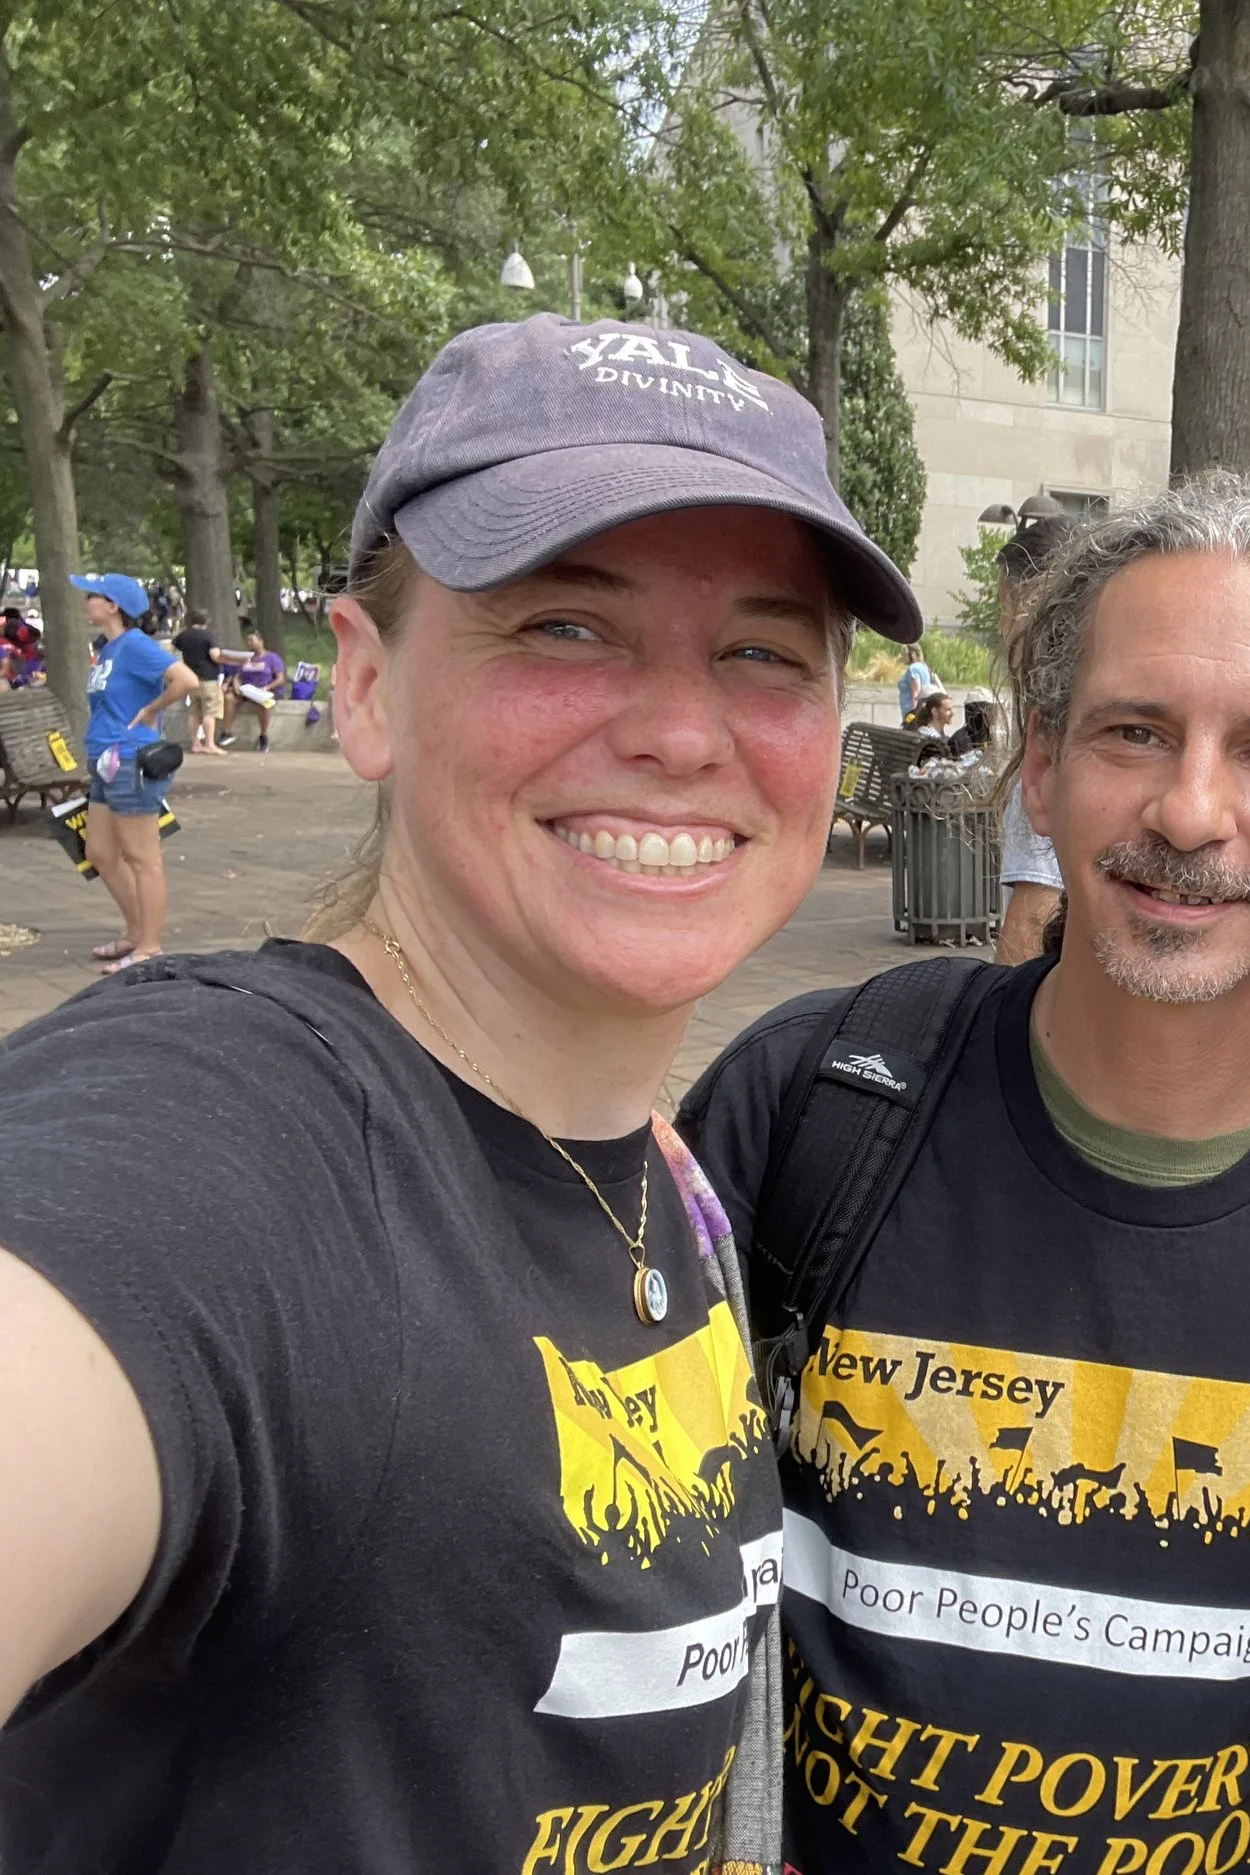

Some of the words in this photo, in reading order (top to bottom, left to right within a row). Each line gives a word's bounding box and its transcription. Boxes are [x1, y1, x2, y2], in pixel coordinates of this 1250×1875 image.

[568, 333, 769, 412] YALE
[595, 367, 745, 411] DIVINITY
[831, 1061, 861, 1075] HIGH
[904, 1351, 1065, 1417] Jersey
[842, 1568, 923, 1615] Poor
[936, 1586, 1091, 1642] People's
[677, 1637, 739, 1687] Poor
